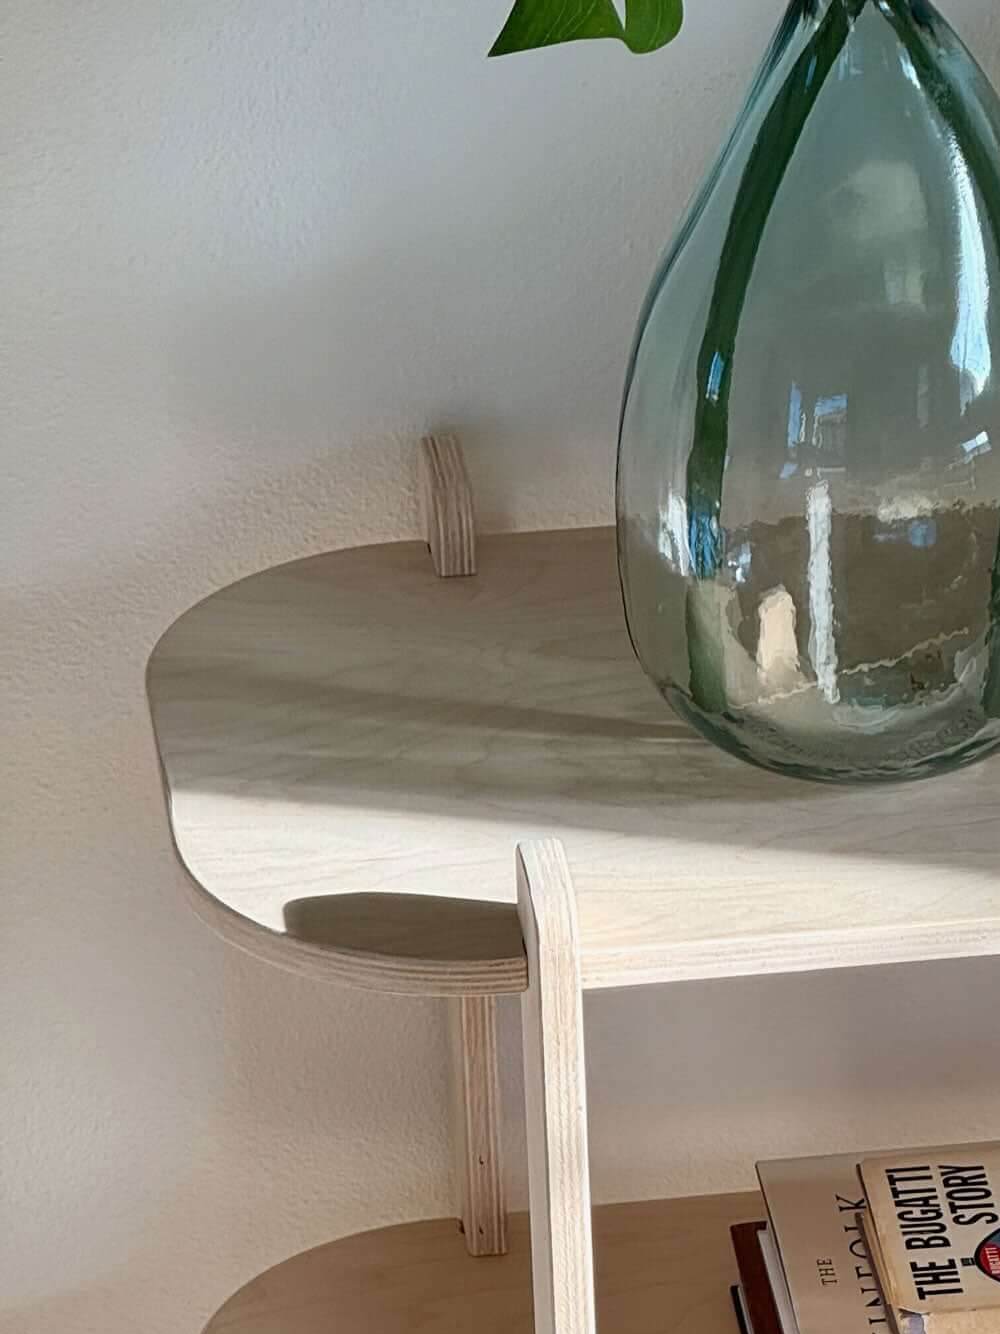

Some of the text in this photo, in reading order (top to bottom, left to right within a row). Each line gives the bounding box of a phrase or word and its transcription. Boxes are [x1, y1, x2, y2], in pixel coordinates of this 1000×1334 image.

[938, 1165, 999, 1226] STORY
[885, 1165, 964, 1301] THE BUGATTI
[816, 1257, 838, 1286] THE
